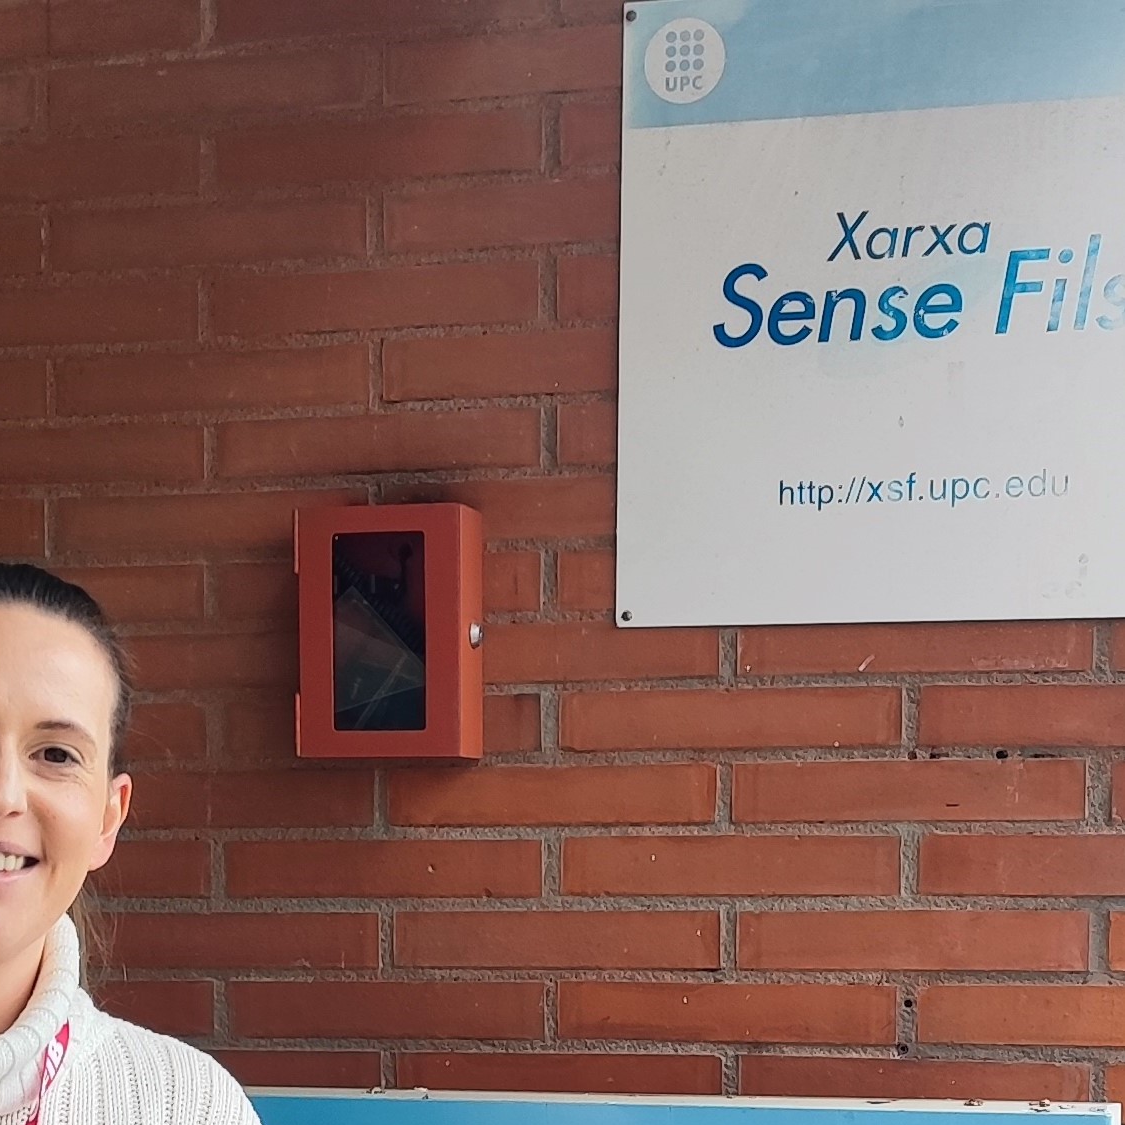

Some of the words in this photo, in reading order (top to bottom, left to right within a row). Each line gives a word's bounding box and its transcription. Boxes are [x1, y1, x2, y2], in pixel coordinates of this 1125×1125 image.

[665, 75, 703, 92] UPC
[827, 210, 991, 262] Xarxa
[712, 263, 963, 348] Sense
[778, 469, 1070, 511] http://xsf.upc.edu
